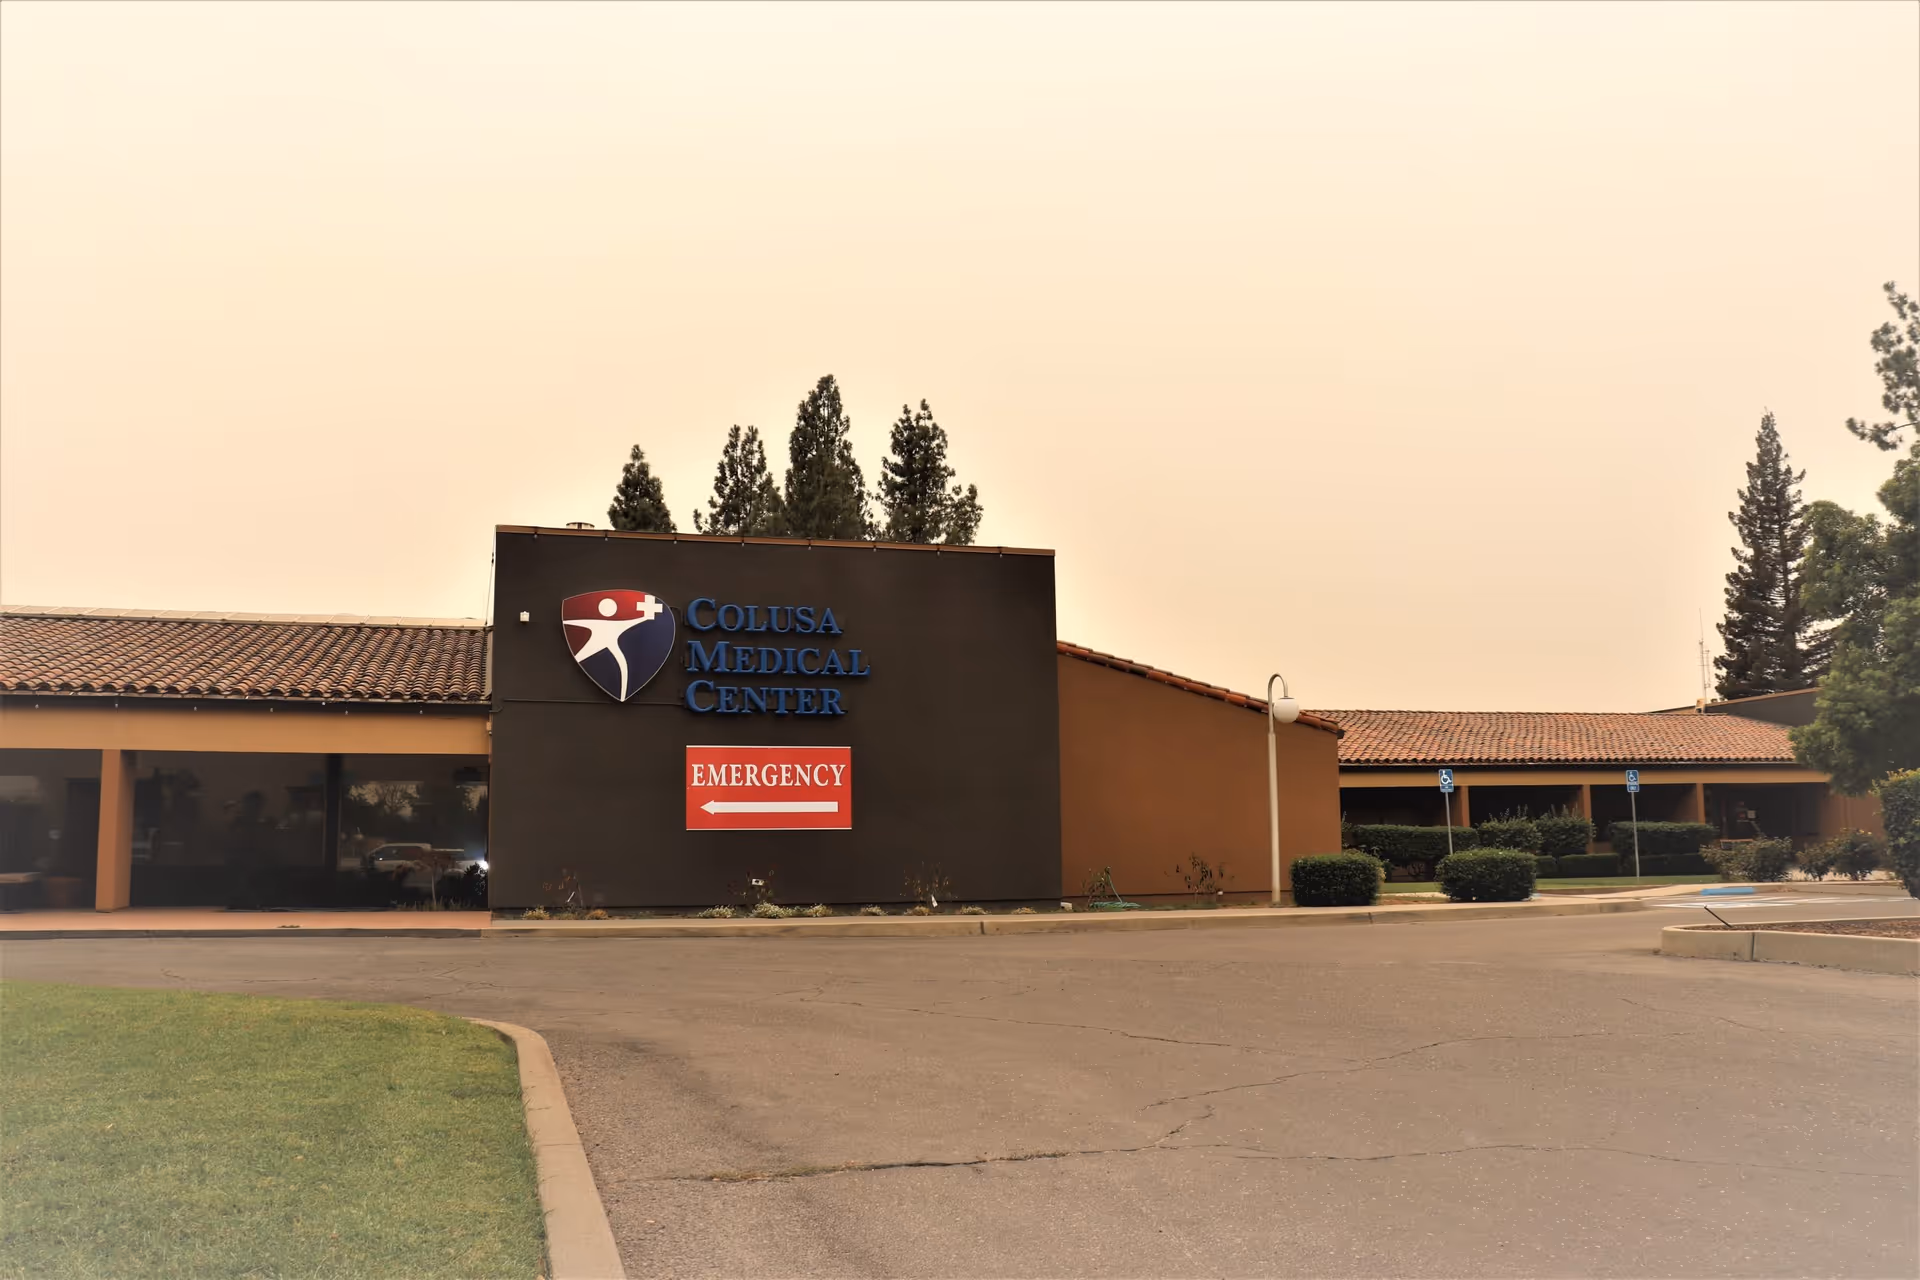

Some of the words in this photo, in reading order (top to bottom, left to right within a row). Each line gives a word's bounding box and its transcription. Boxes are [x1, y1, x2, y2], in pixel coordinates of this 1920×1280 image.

[686, 597, 843, 634] COLUSA
[686, 640, 870, 676] MEDICAL
[685, 680, 845, 715] CENTER
[691, 763, 846, 787] EMERGENCY
